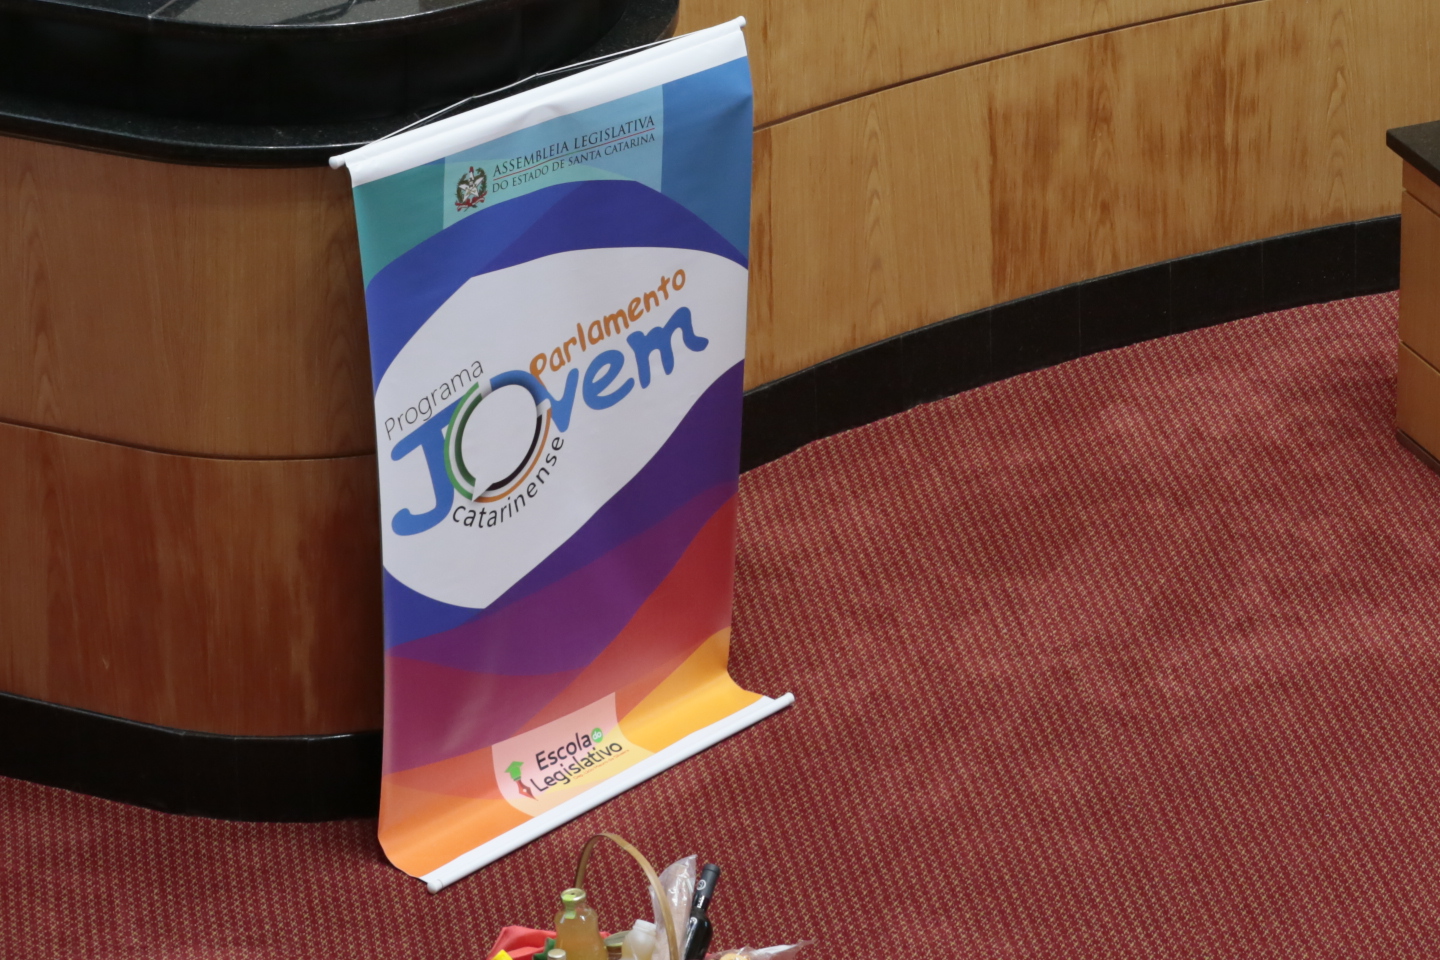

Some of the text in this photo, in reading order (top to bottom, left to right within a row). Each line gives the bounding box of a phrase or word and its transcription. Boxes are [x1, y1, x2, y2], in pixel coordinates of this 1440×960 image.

[492, 115, 656, 178] ASSEMBLEIA LEGISLATIVA
[492, 132, 656, 193] DO ESTADO DE SANTA CATARINA
[529, 269, 687, 389] Parlamento
[384, 360, 484, 441] Programa
[530, 742, 623, 792] Legislativo
[535, 732, 593, 771] Escola
[592, 730, 603, 741] do
